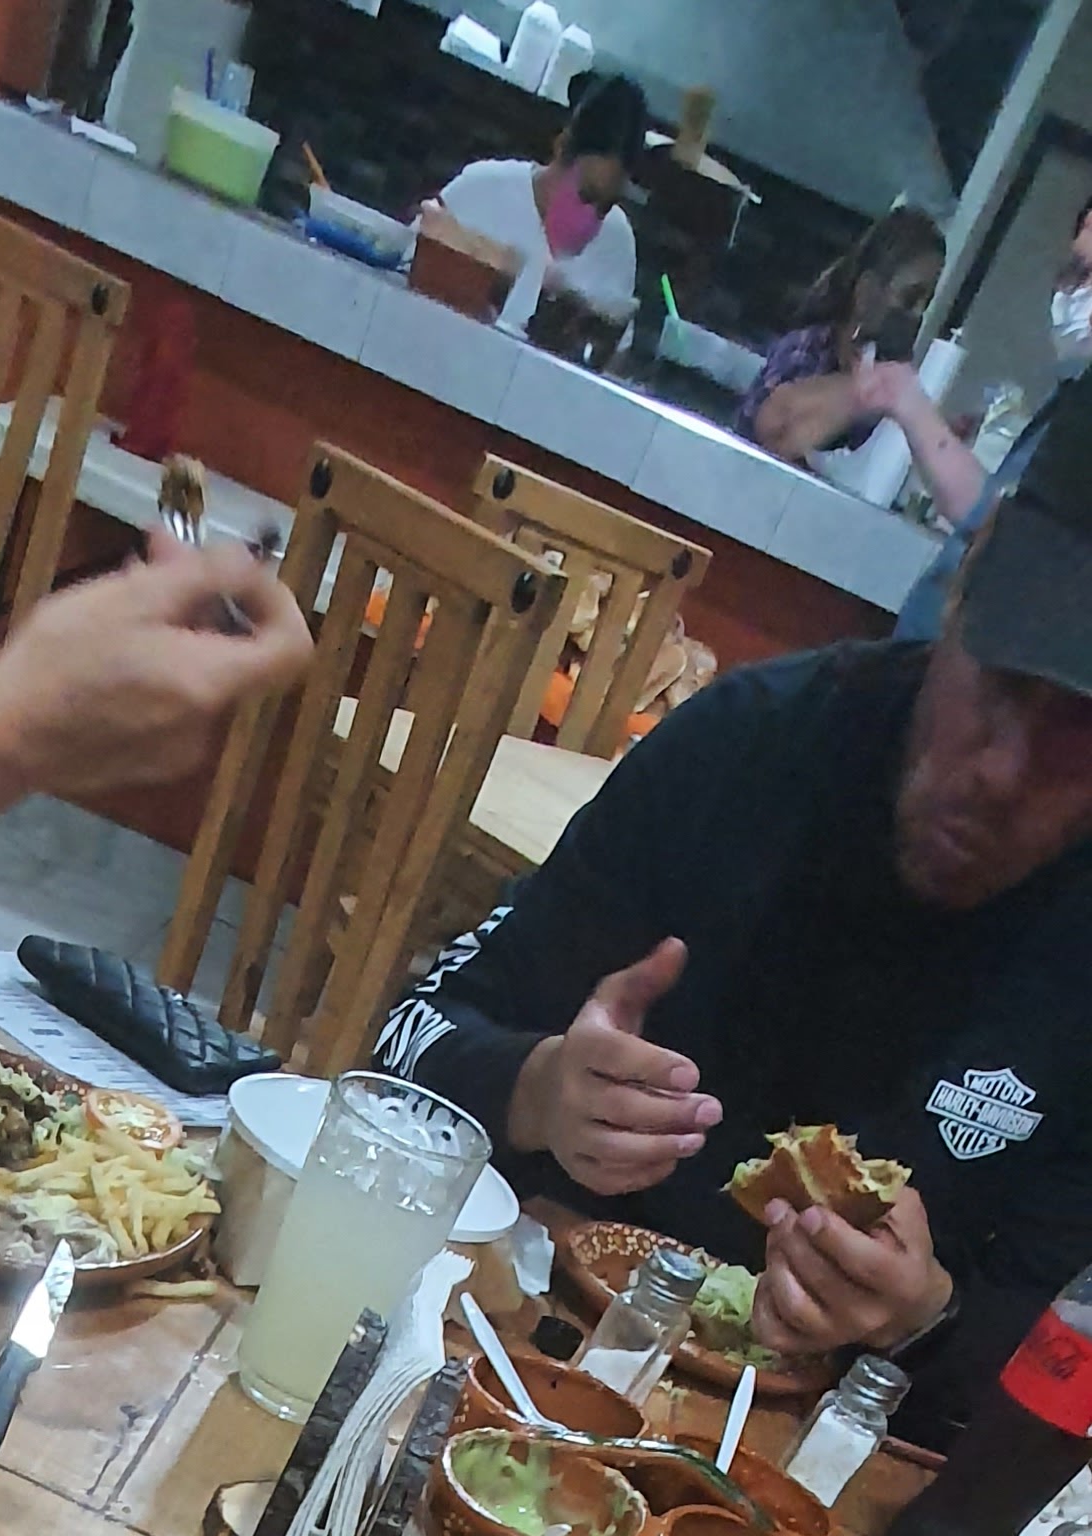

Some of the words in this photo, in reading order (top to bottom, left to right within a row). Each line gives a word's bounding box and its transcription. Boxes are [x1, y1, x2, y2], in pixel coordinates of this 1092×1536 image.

[970, 1074, 1025, 1106] MOTOR
[934, 1086, 1037, 1134] HARLEY-DAVIDSON
[946, 1120, 999, 1153] CYCLES
